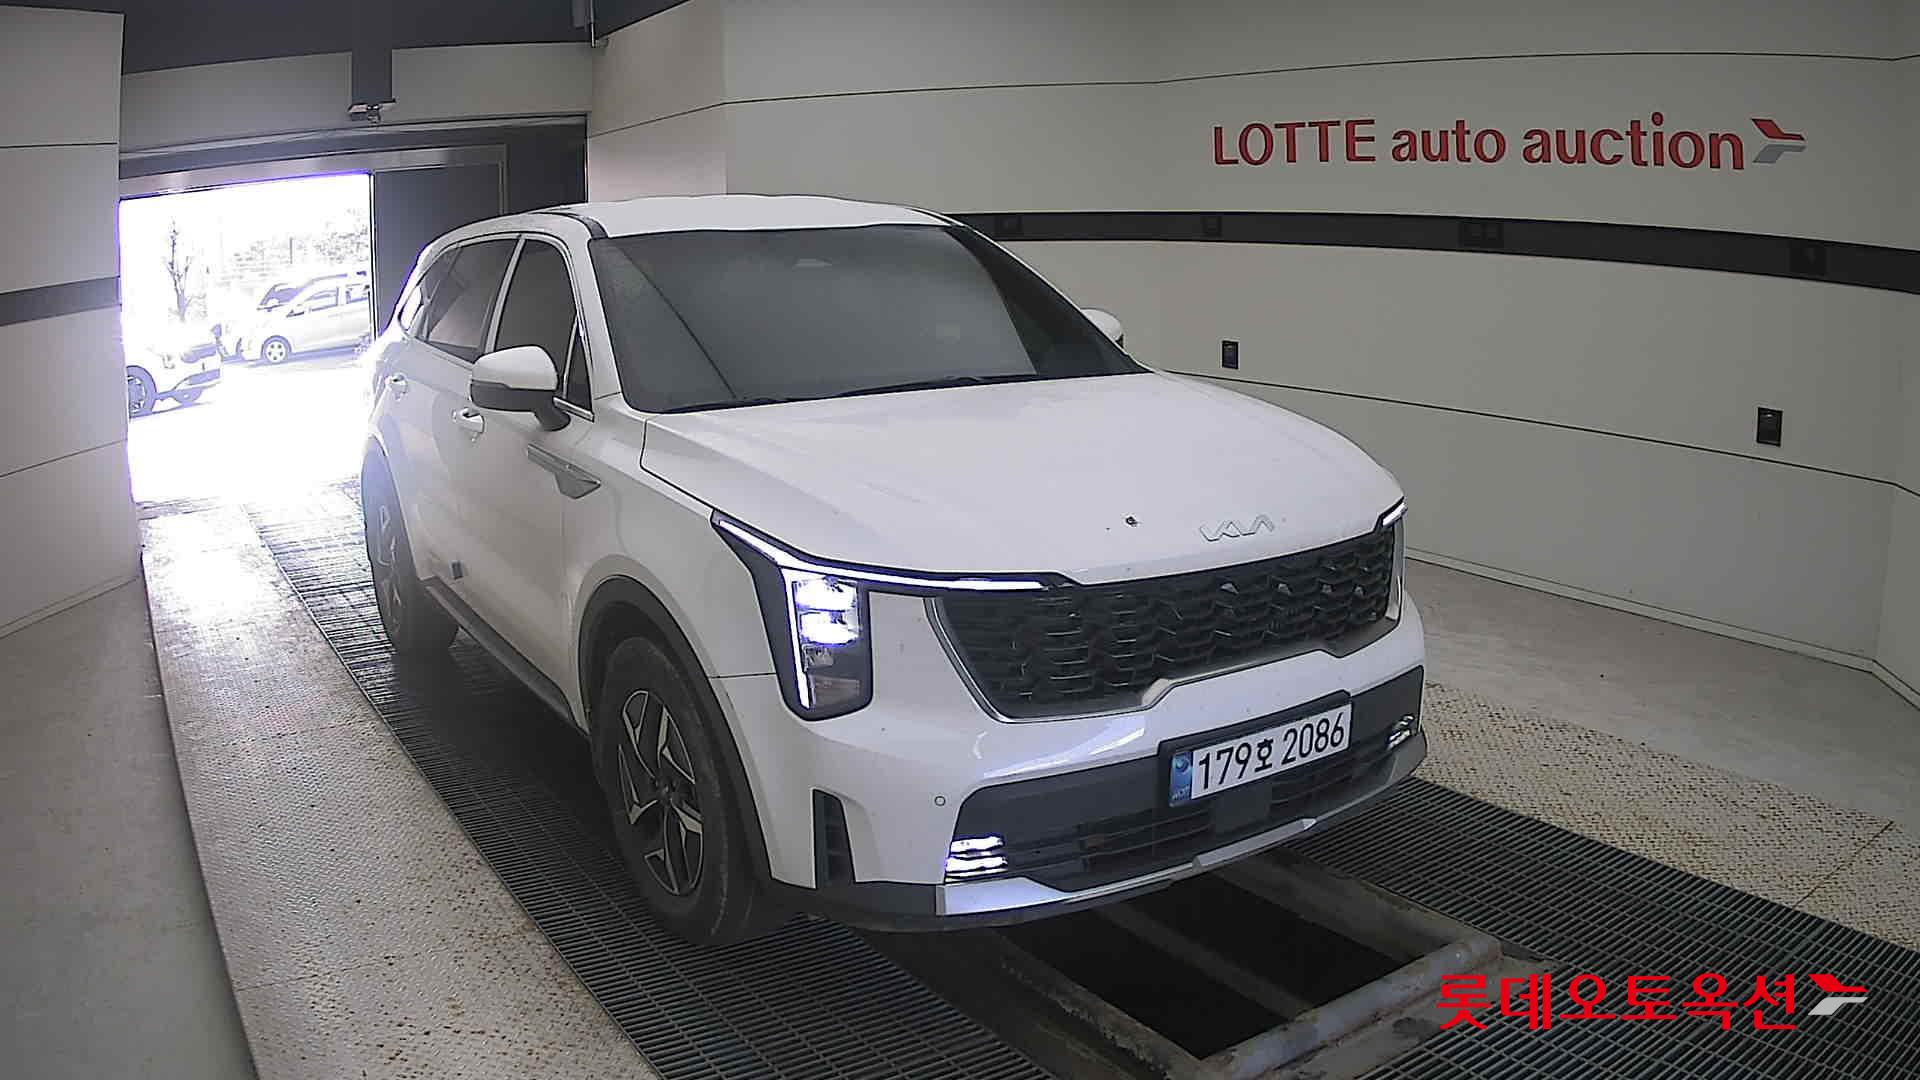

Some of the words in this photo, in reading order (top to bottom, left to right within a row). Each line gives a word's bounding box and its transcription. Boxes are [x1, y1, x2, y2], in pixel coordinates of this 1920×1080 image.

[1212, 118, 1376, 167] LOTTE
[1391, 119, 1506, 164] auto
[1522, 111, 1745, 171] auction
[1198, 737, 1274, 790] 179호
[1281, 711, 1345, 766] 2086
